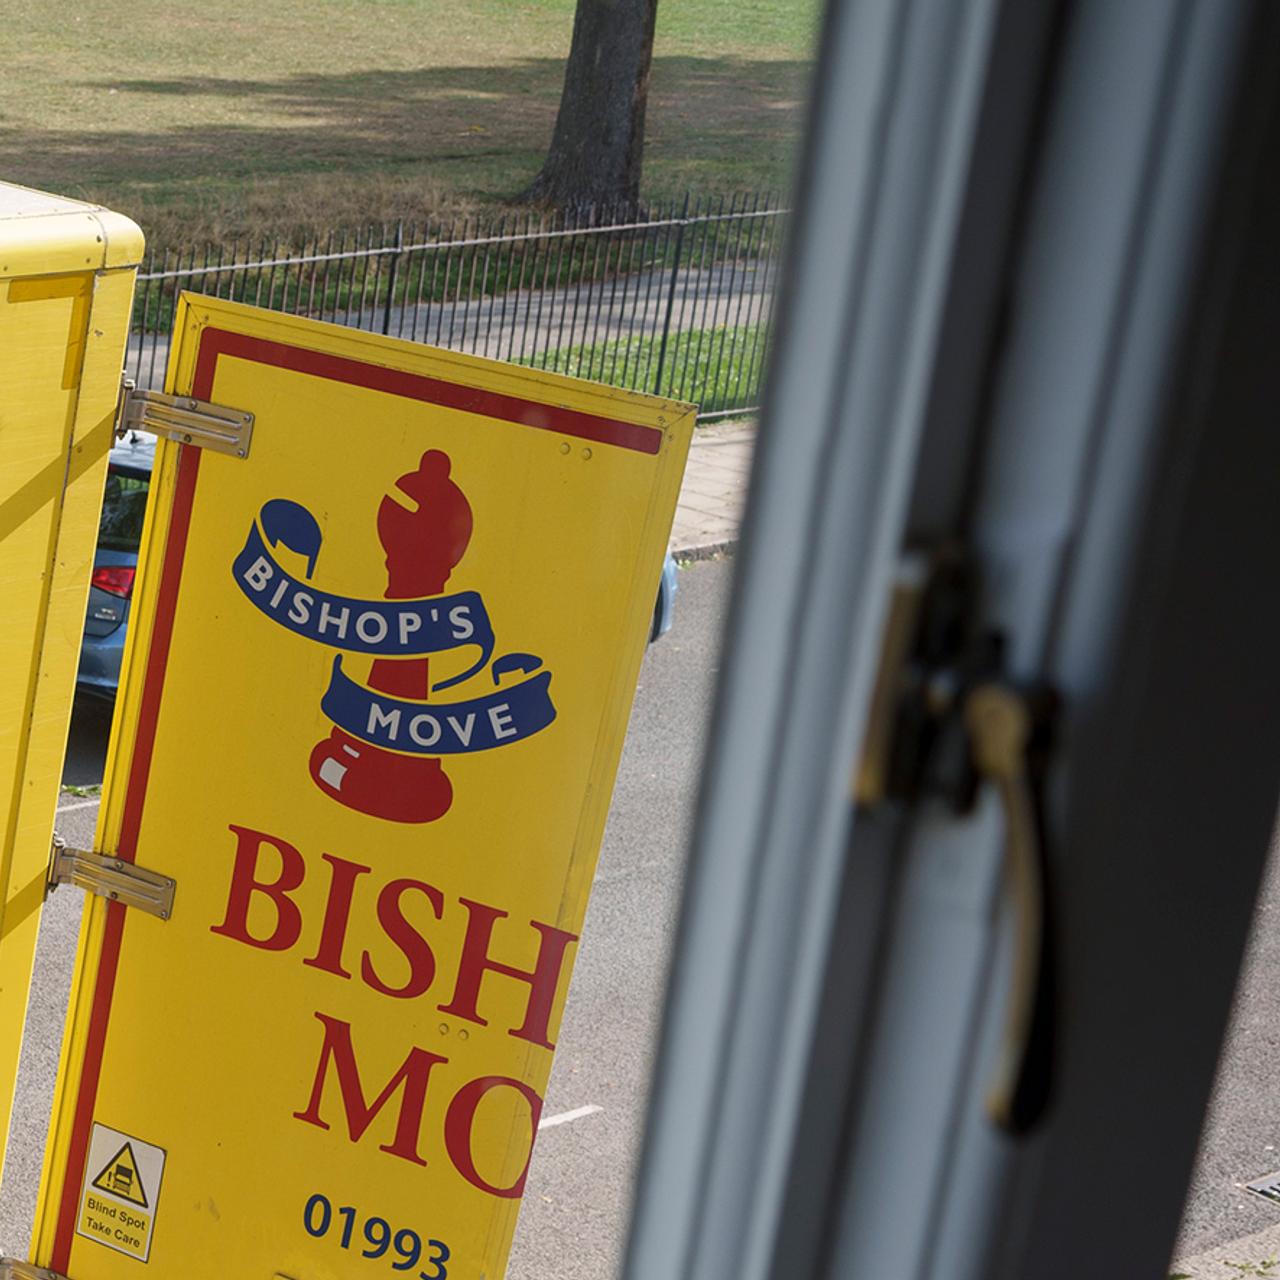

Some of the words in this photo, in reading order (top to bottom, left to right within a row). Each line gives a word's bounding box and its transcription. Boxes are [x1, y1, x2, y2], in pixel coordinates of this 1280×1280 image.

[243, 556, 474, 645] BISHOP'S
[366, 702, 518, 748] MOVE
[210, 824, 579, 1051] BISH
[293, 1011, 544, 1199] MO
[86, 1216, 112, 1236] Take
[114, 1229, 140, 1248] Care
[87, 1198, 117, 1218] Blind
[119, 1211, 146, 1231] Spot
